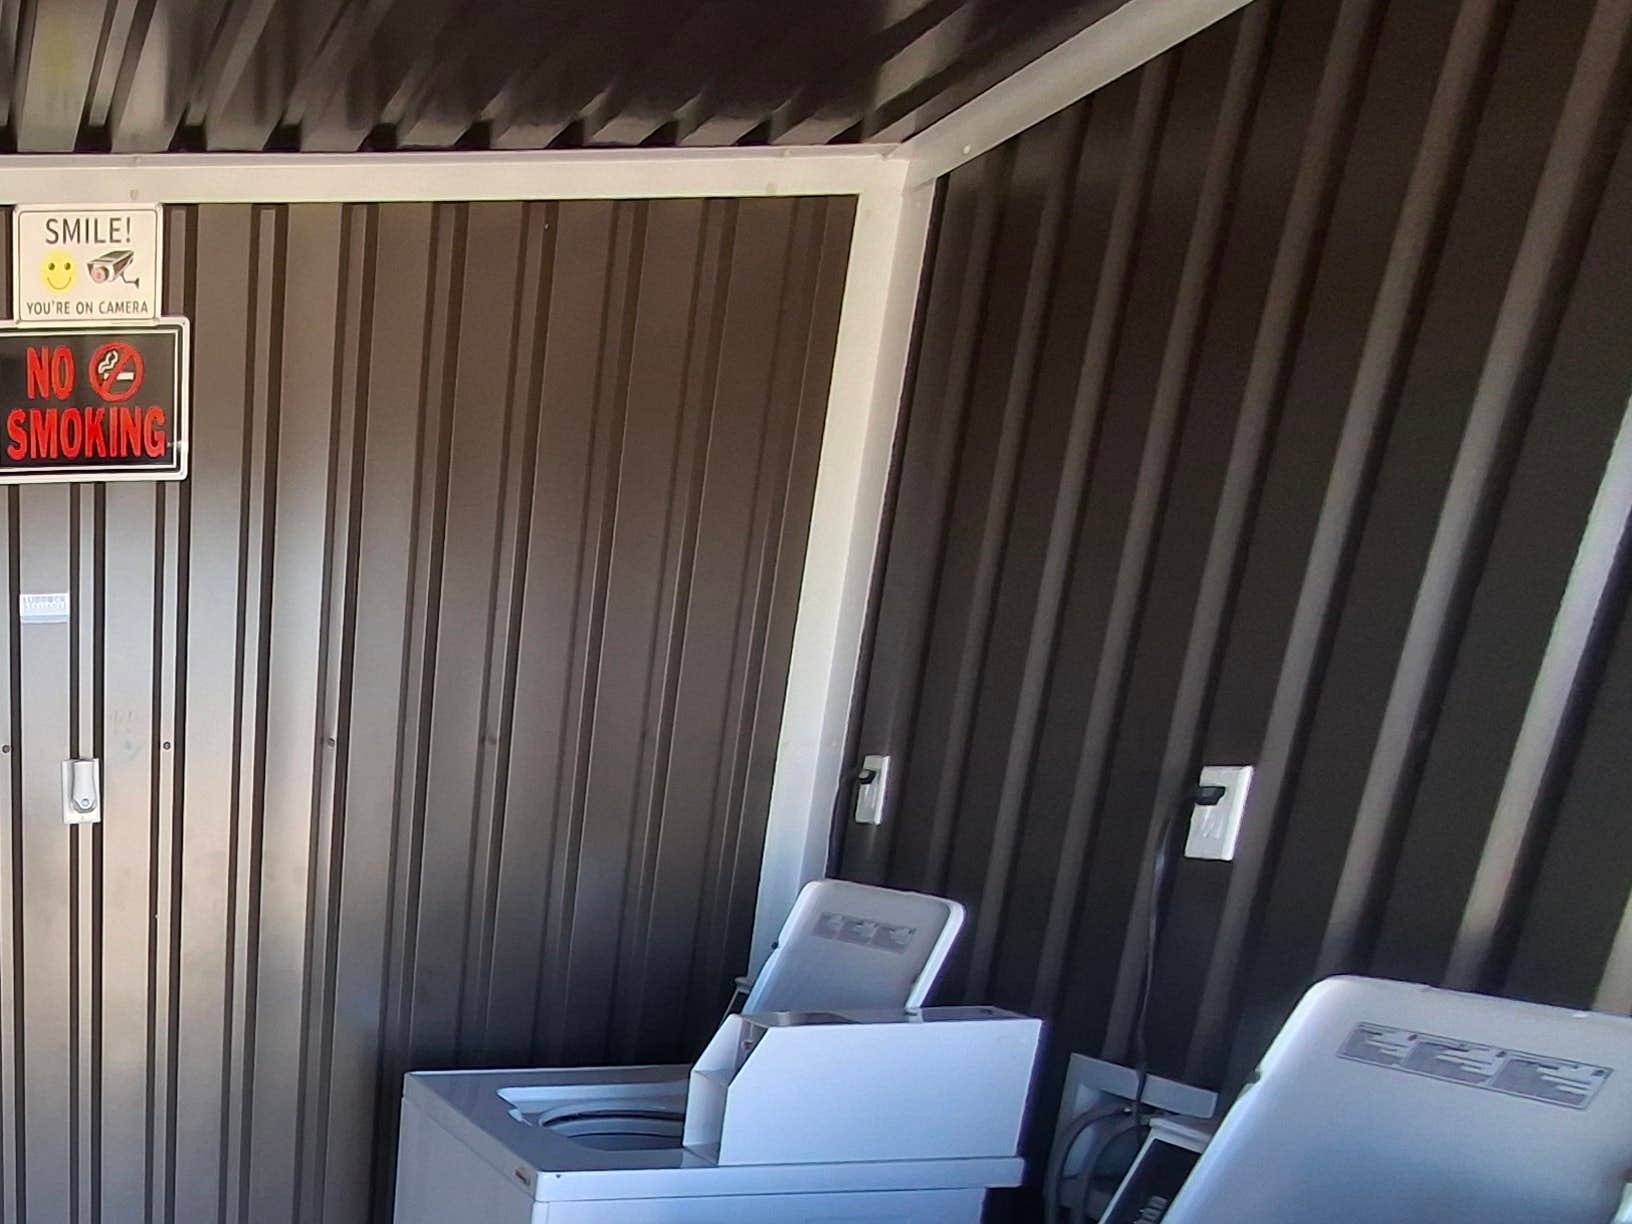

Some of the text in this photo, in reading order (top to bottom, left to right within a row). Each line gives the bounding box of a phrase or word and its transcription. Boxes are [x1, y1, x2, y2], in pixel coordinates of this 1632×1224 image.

[45, 217, 132, 244] SMILE!
[26, 299, 148, 315] YOU'RE ON CAMERA
[25, 345, 76, 400] NO
[6, 406, 167, 461] SMOKING
